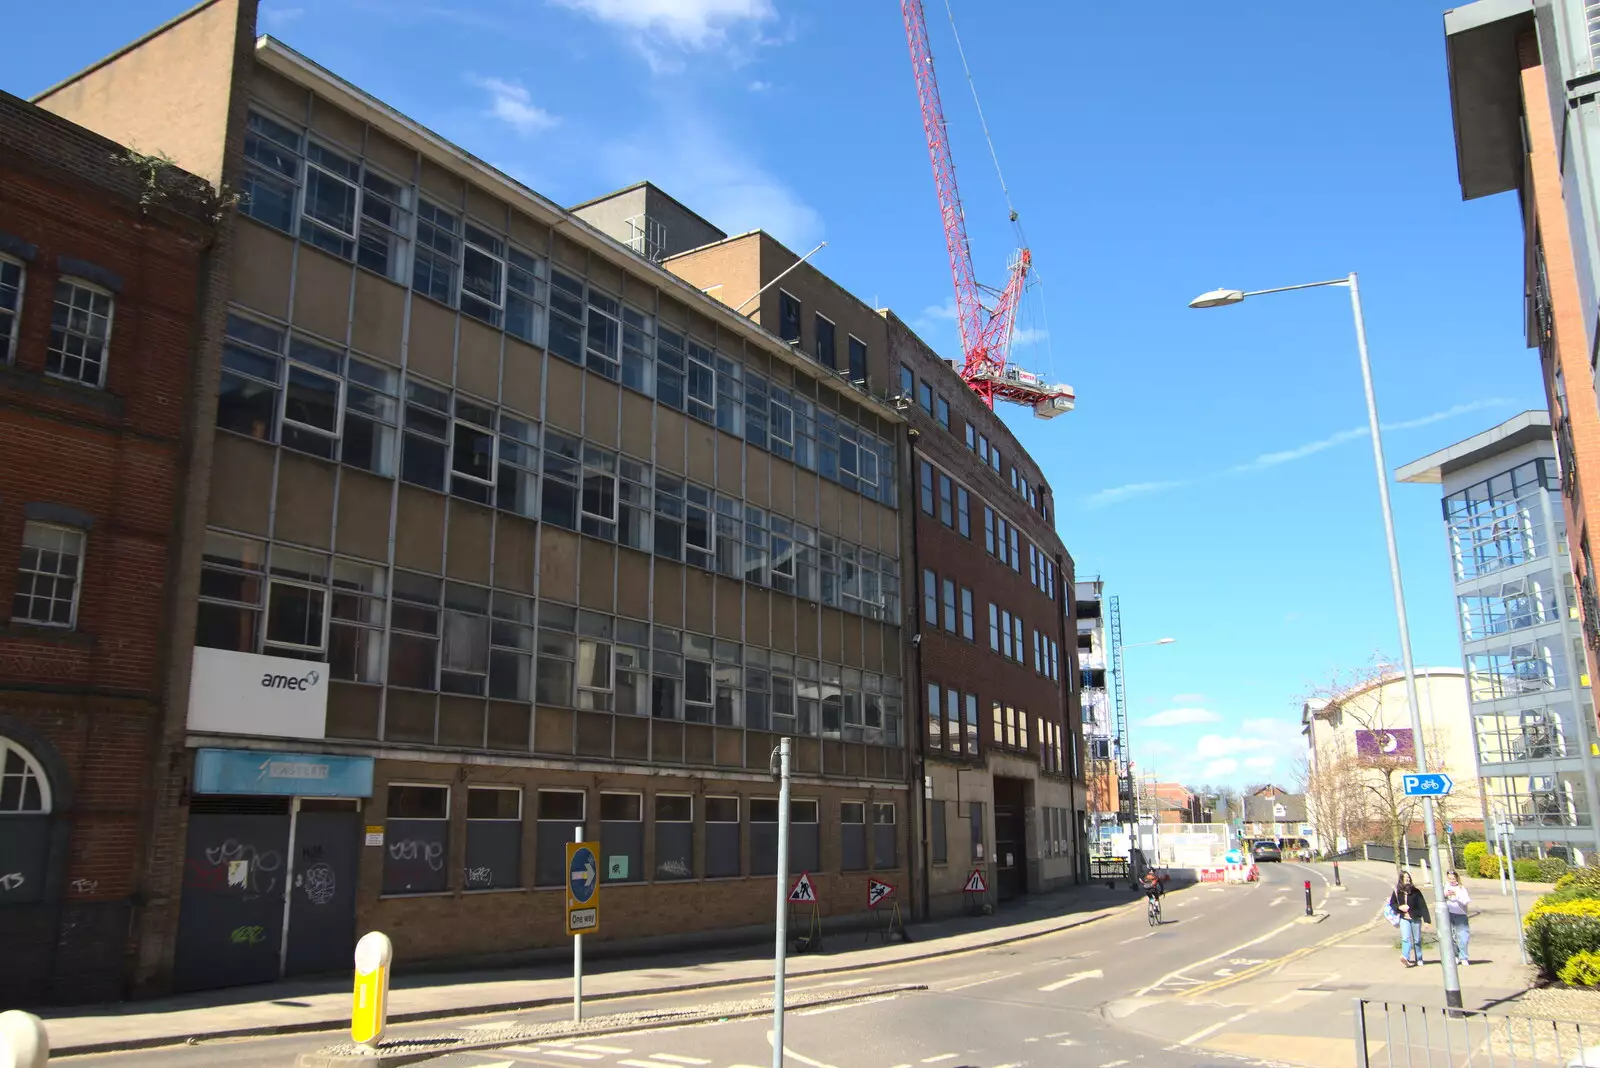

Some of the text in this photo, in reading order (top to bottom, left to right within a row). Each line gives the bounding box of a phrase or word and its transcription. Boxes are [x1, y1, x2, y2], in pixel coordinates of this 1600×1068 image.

[261, 673, 309, 691] amec
[1404, 777, 1420, 793] P
[572, 913, 595, 924] One way
